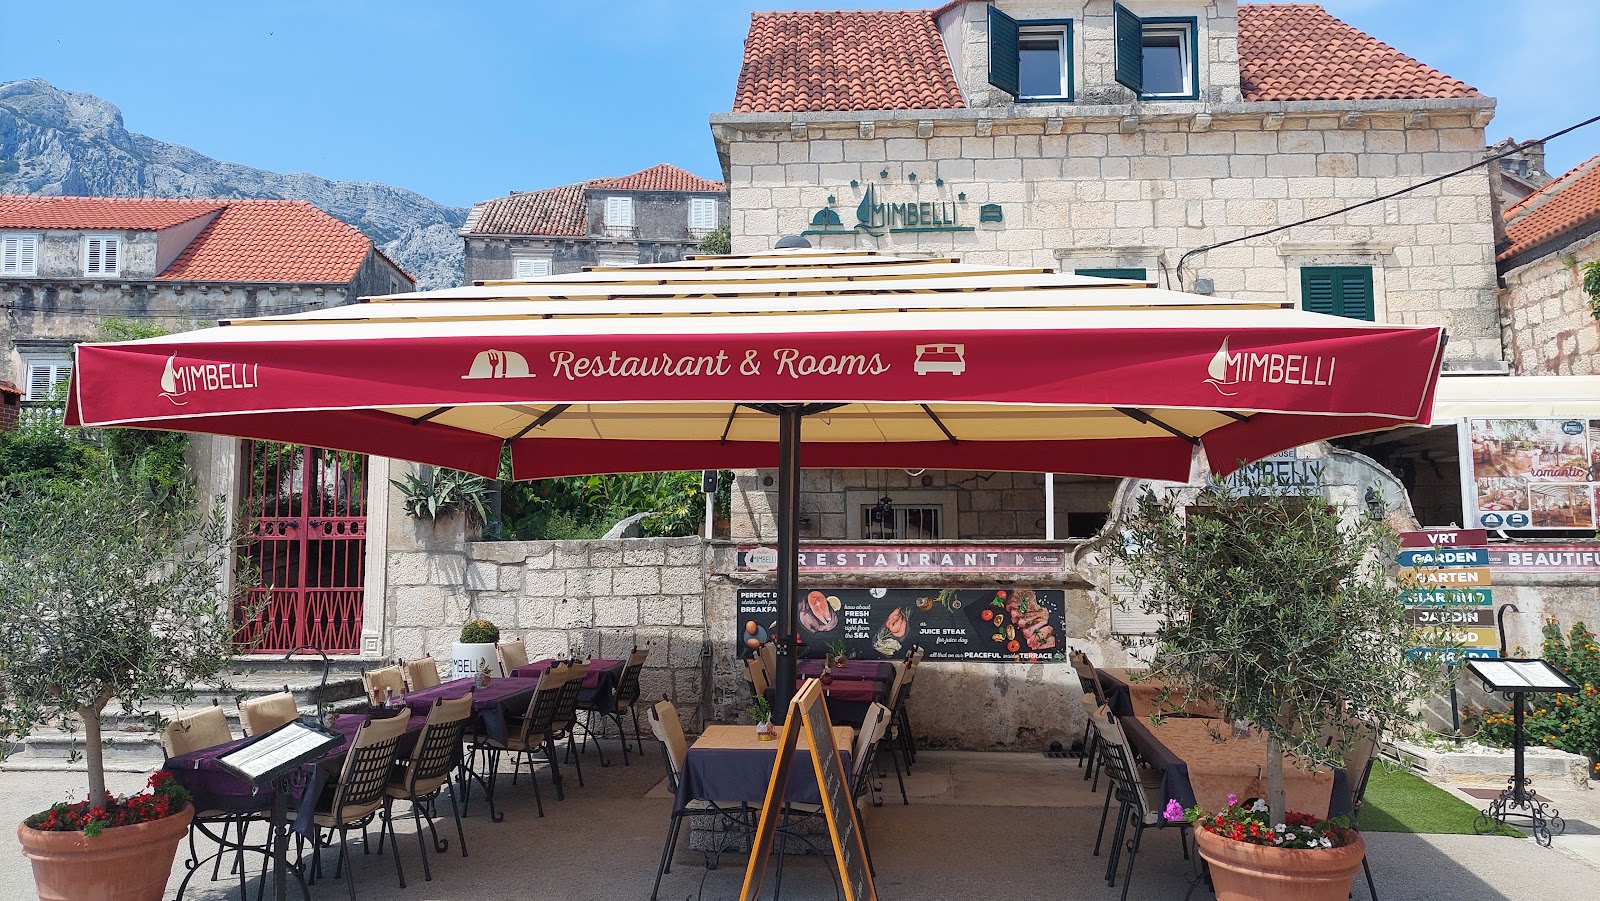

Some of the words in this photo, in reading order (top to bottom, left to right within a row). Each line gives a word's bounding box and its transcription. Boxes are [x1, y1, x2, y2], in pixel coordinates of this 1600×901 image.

[871, 202, 956, 227] MIMBELLI
[549, 350, 731, 381] Restaurant
[739, 350, 761, 376] &
[773, 348, 891, 379] Rooms
[1223, 352, 1336, 386] MIMBELLI
[172, 362, 258, 392] MIMBELLI
[1531, 466, 1584, 477] romantic
[1428, 533, 1458, 544] VRT
[798, 553, 998, 566] RESTAURANT
[1412, 551, 1477, 564] GARDEN
[1416, 571, 1479, 583] GARTEN
